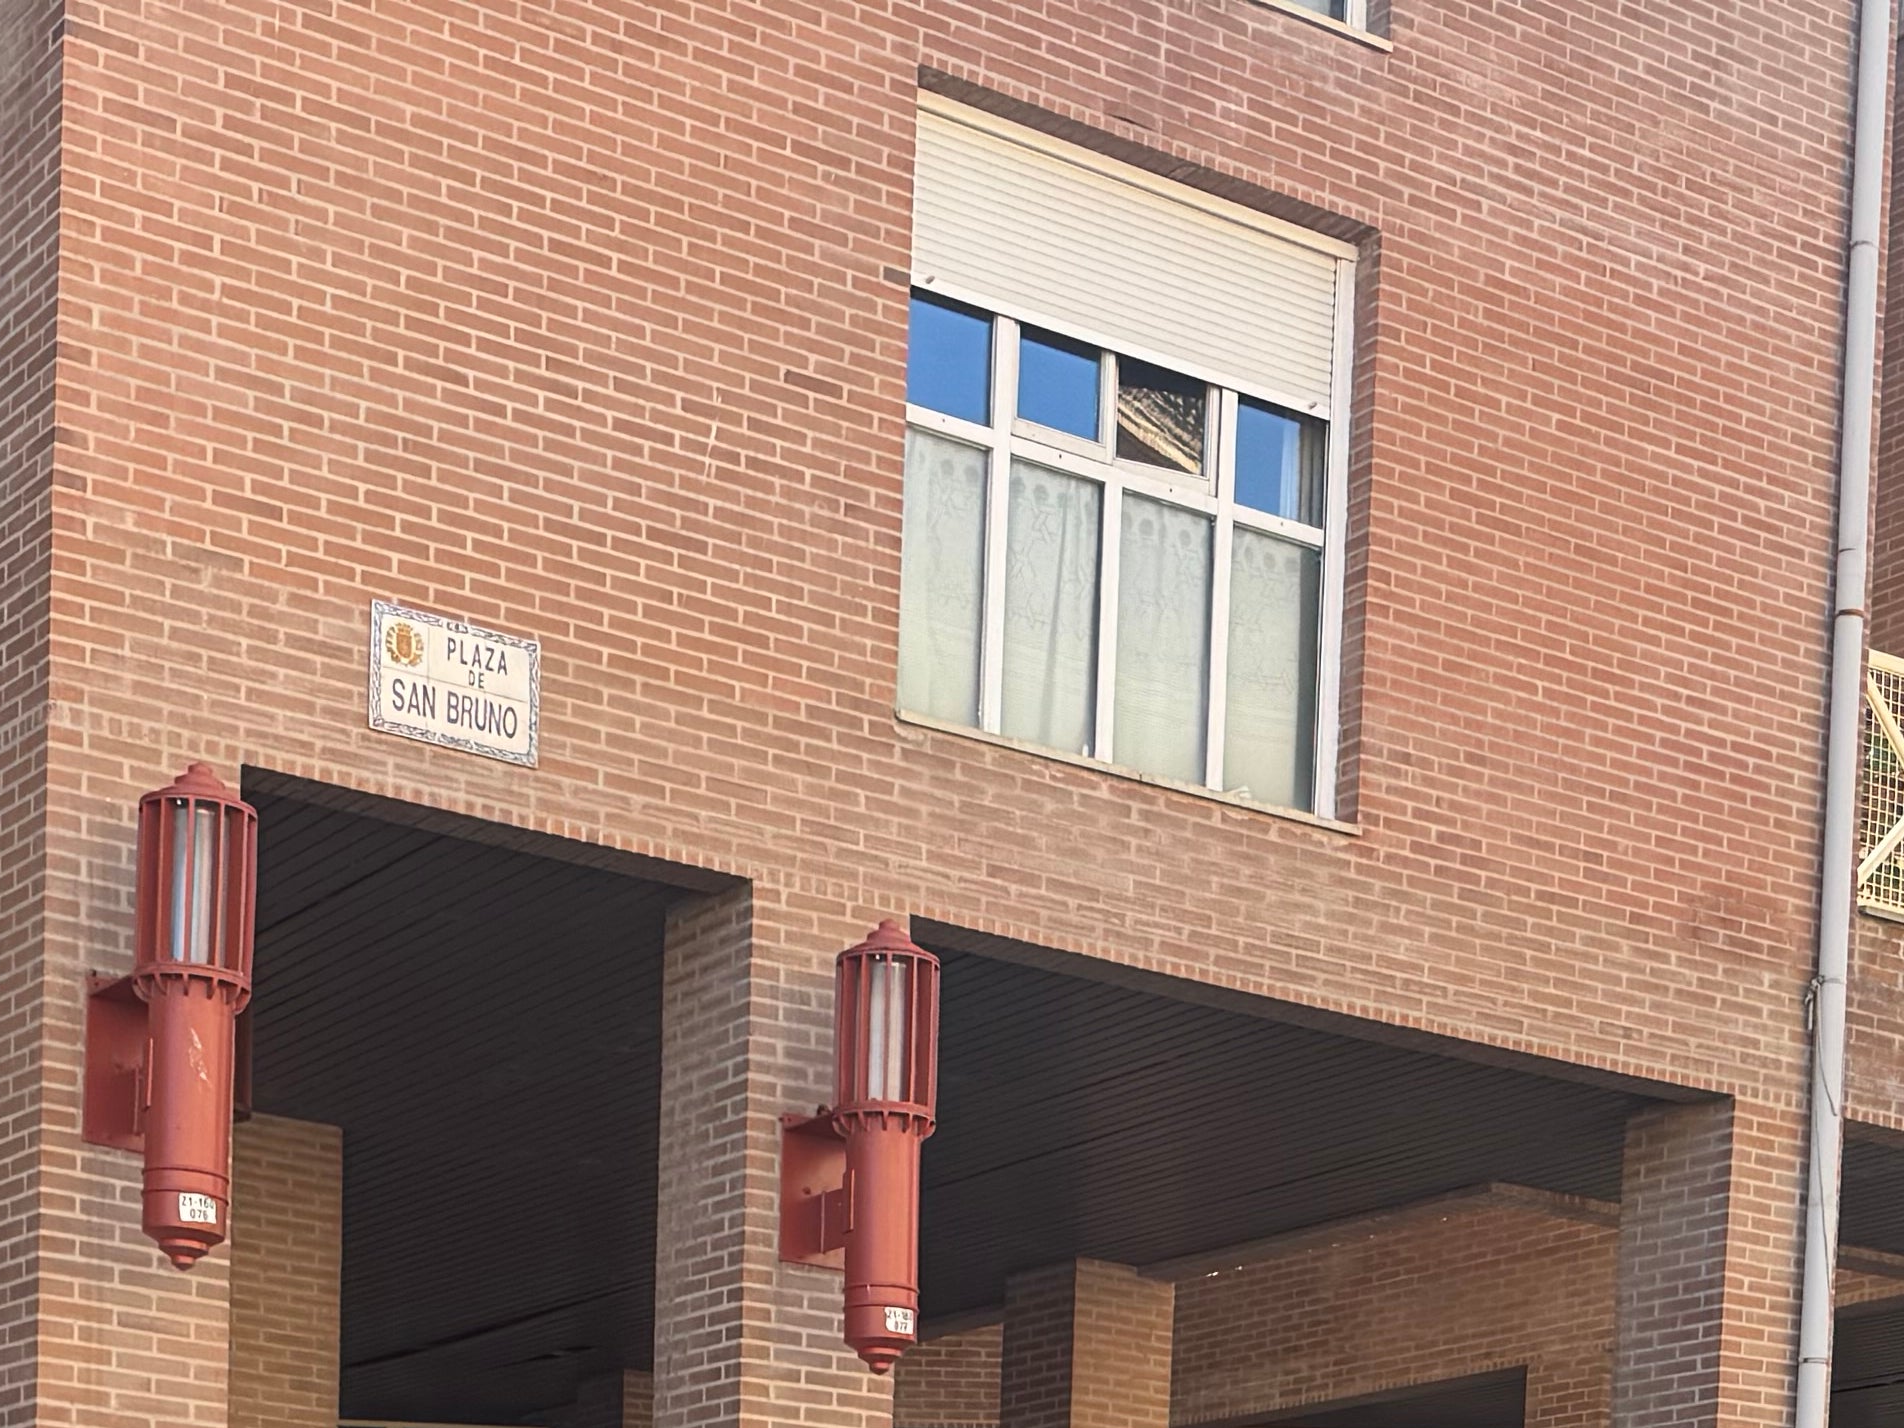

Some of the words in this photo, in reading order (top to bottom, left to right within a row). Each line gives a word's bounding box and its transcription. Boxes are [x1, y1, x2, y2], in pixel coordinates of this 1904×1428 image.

[448, 638, 507, 675] PLAZA
[468, 670, 485, 689] DE
[392, 679, 435, 720] SAN
[447, 691, 517, 739] BRUNO
